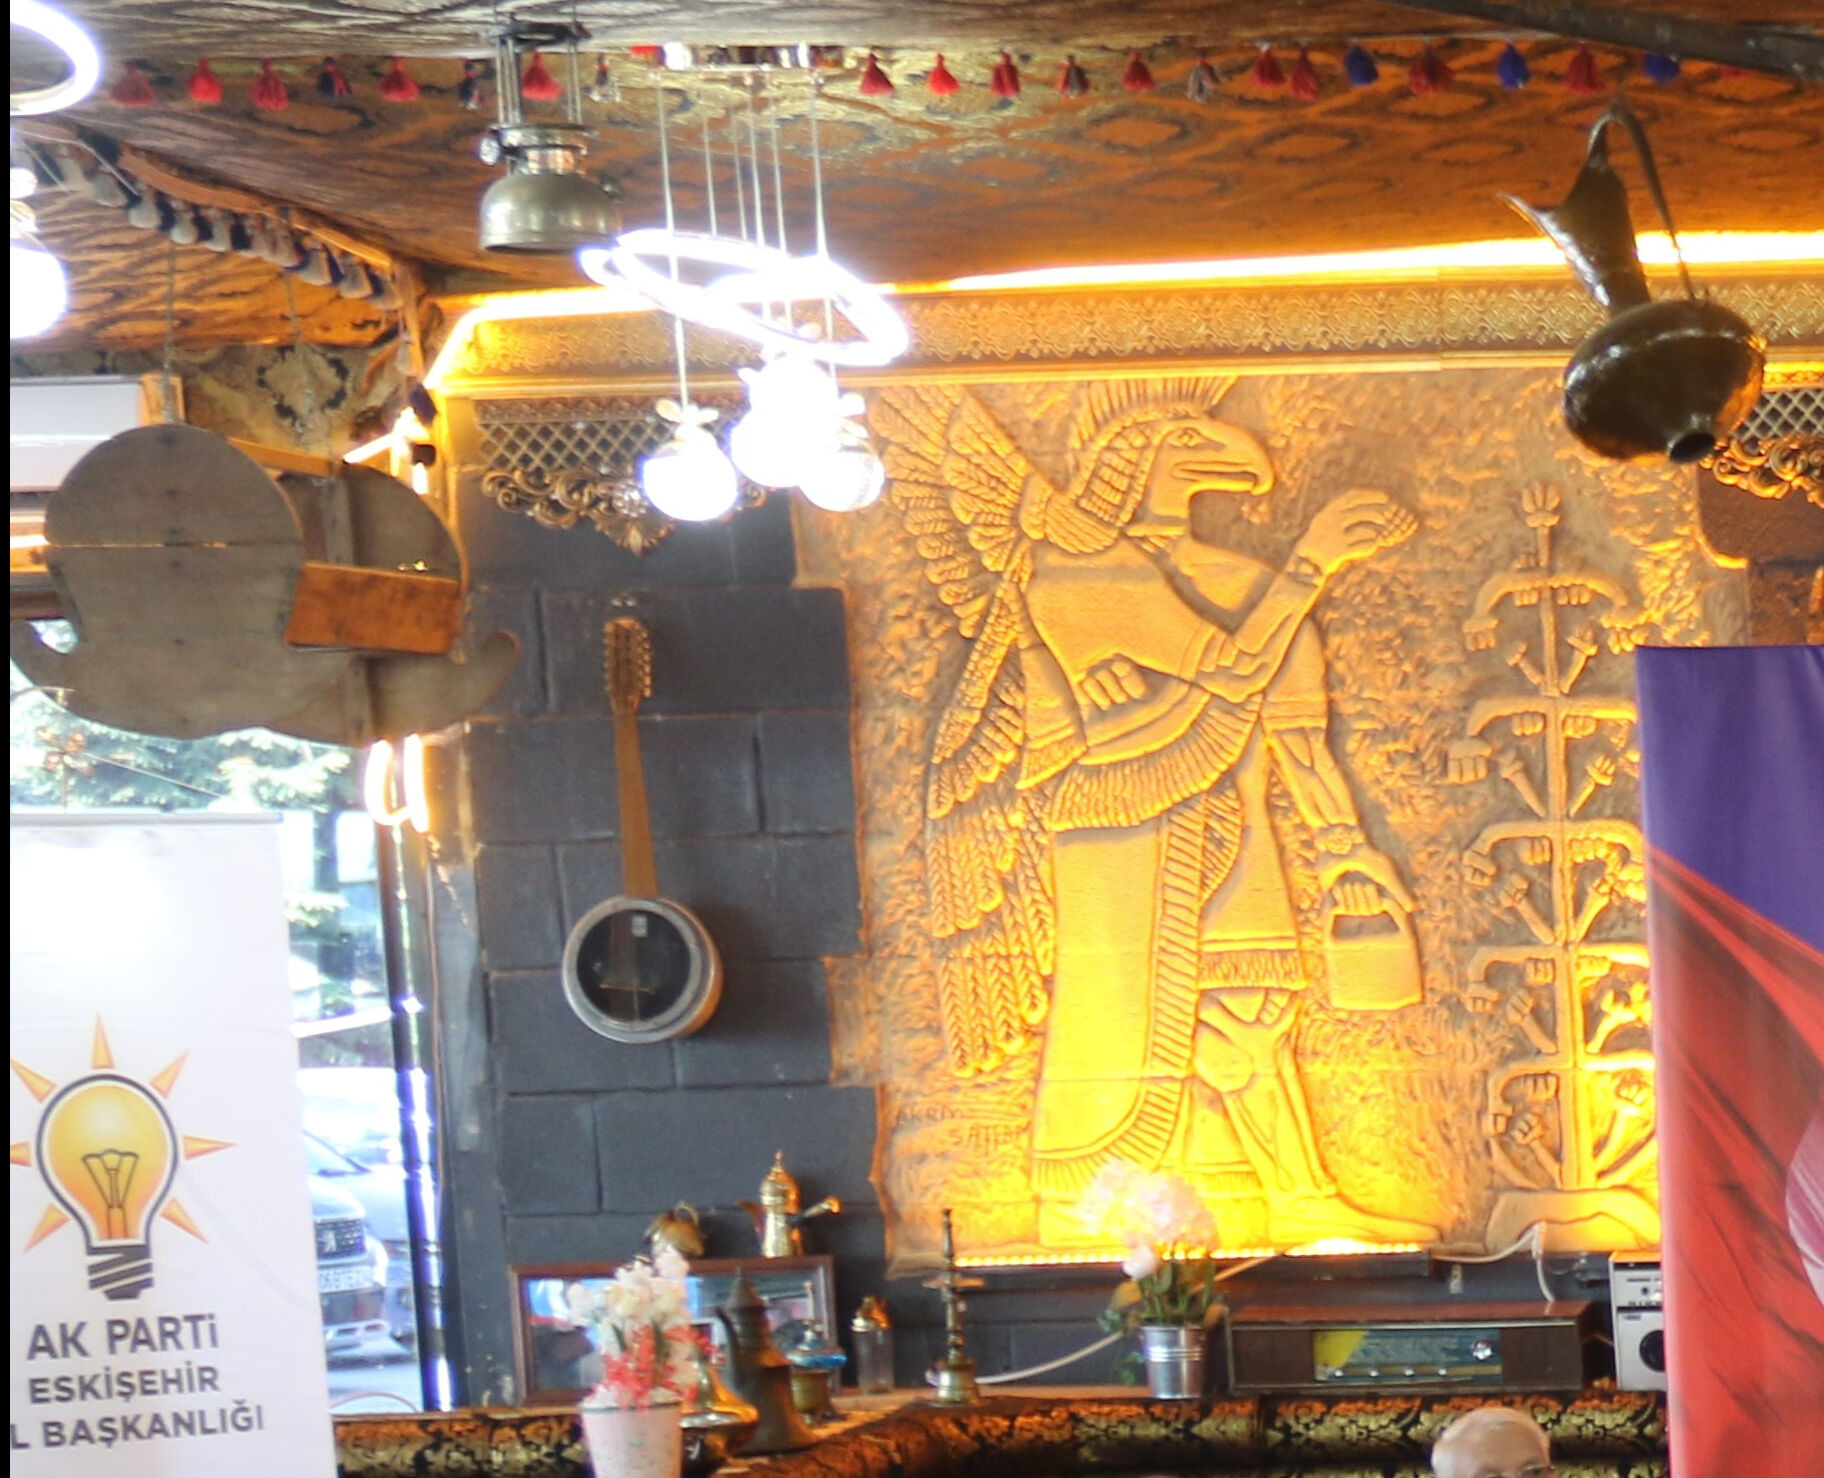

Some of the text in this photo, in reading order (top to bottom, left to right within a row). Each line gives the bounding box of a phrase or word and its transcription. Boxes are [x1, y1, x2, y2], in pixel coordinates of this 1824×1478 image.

[27, 1321, 90, 1361] AK
[28, 1360, 220, 1405] ESKİŞEHİR
[10, 1399, 264, 1449] L BAŞKANLIĞI
